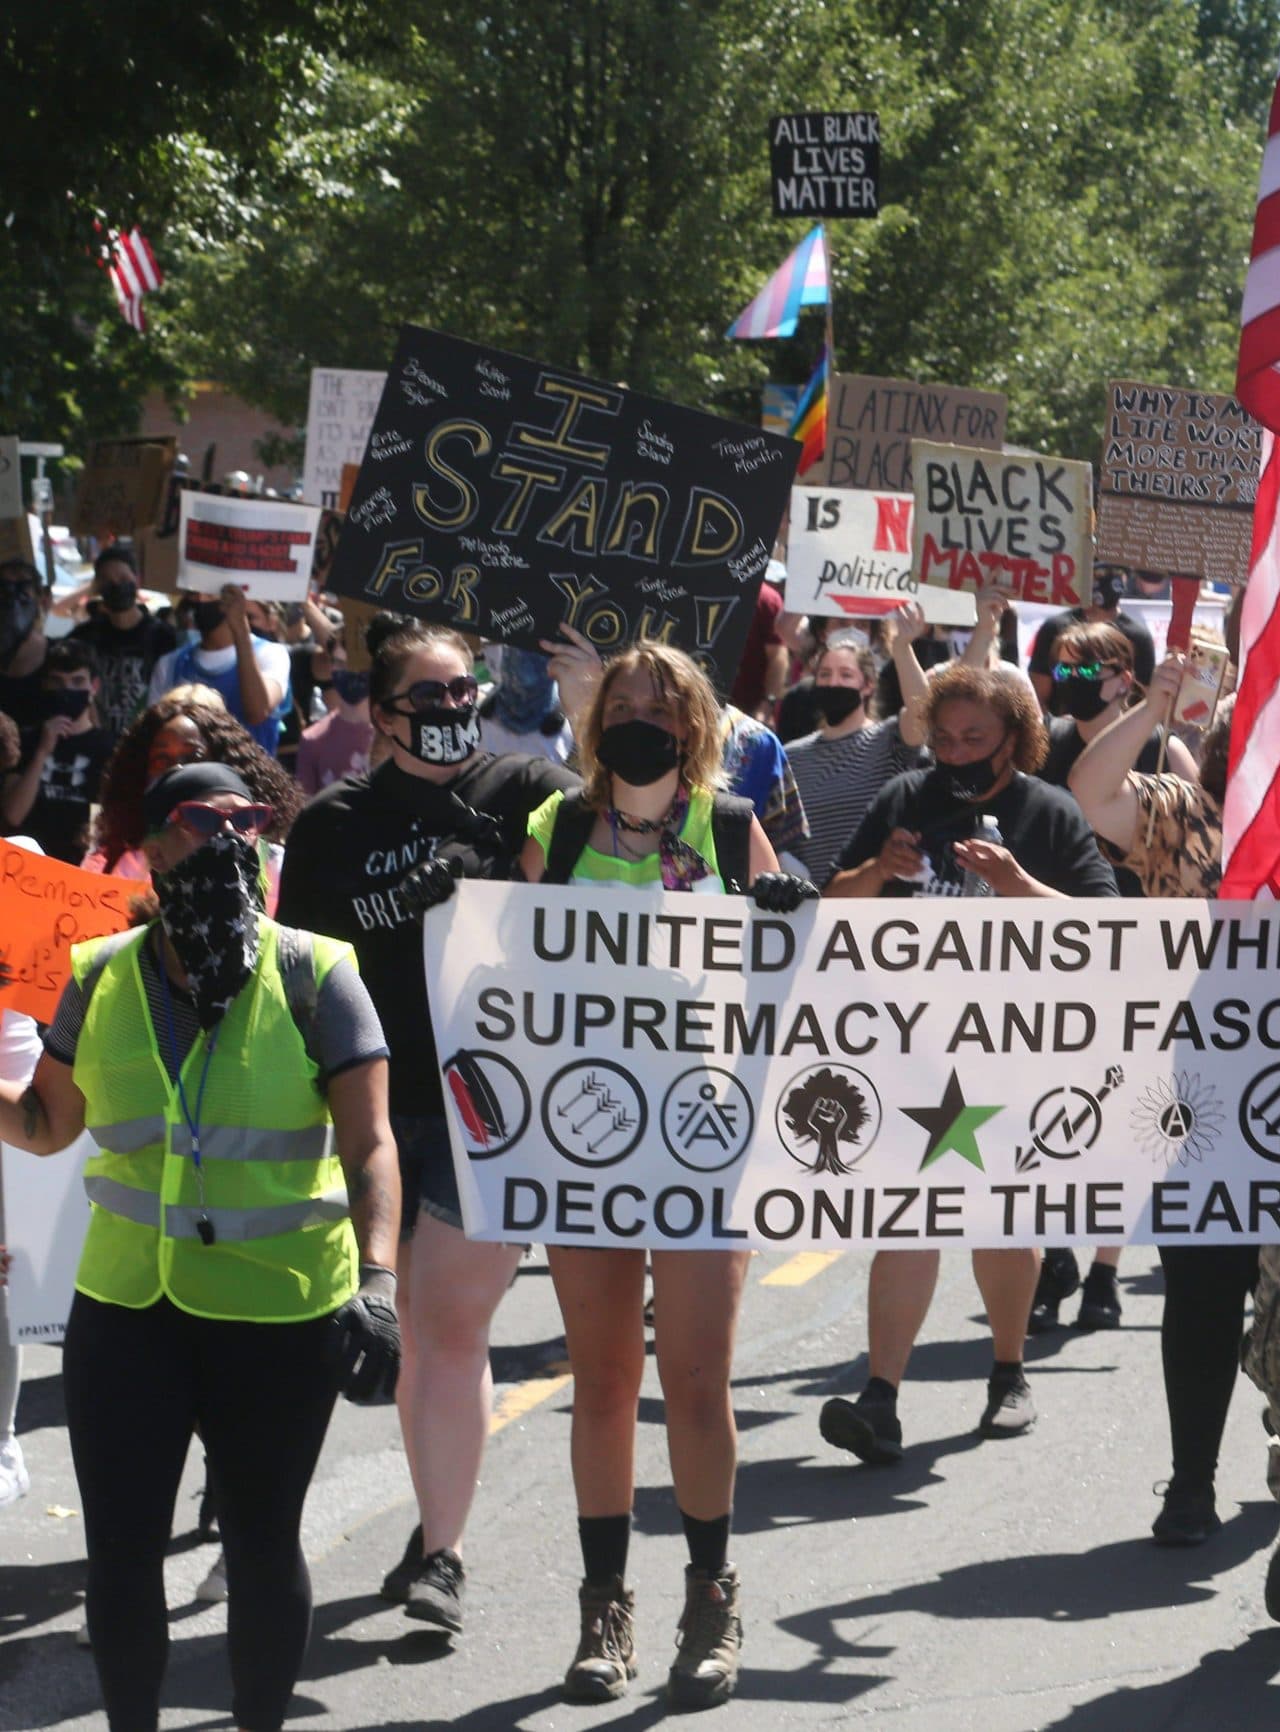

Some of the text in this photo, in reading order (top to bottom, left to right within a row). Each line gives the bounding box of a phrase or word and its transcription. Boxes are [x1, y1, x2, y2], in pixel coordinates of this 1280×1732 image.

[774, 114, 880, 146] ALL BLACK
[793, 146, 865, 175] LIVES
[777, 175, 877, 211] MATTER
[506, 371, 624, 468] I
[836, 385, 998, 439] LATINX FOR
[1113, 385, 1251, 424] WHY IS M
[1104, 440, 1188, 471] MORE
[1110, 414, 1264, 452] LIFE WORT
[733, 448, 784, 474] Martin
[926, 458, 1074, 515] BLACK
[1108, 468, 1234, 503] THEIRS?
[805, 496, 843, 532] IS
[941, 515, 1067, 558] LIVES
[365, 537, 482, 626] FOR
[918, 533, 1081, 605] MATTER
[420, 713, 481, 763] BLM
[2, 852, 130, 915] Remove
[533, 907, 797, 973] UNITED
[817, 919, 1138, 972] AGAINST
[475, 986, 929, 1057] SUPREMACY
[945, 1002, 1097, 1053] AND
[503, 1176, 965, 1241] DECOLONIZE
[991, 1184, 1125, 1235] THE
